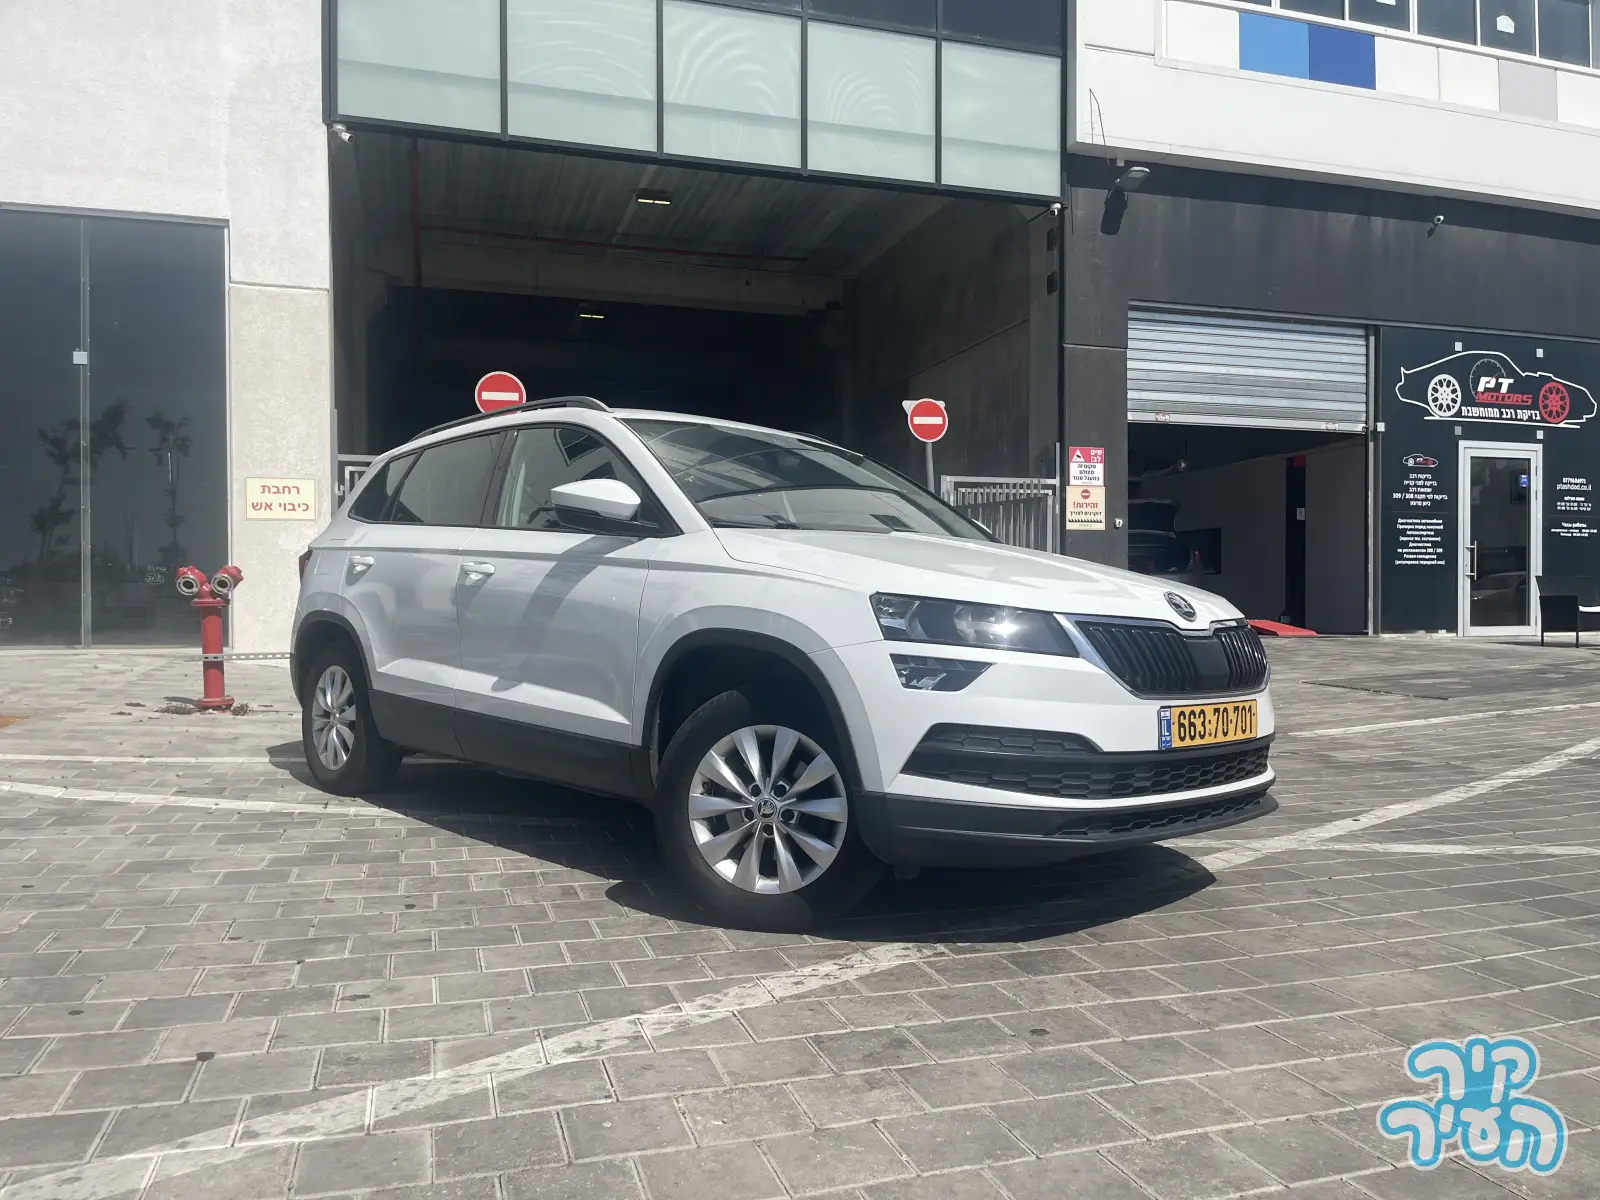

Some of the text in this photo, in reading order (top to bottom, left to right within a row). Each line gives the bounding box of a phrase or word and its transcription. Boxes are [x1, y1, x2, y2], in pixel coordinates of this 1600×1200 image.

[1477, 376, 1514, 394] PT
[1475, 391, 1533, 405] MOTORS
[1461, 406, 1541, 421] בדיקת רכב ממוחשבת
[260, 484, 300, 495] רחבת
[251, 501, 310, 512] כיבוי אש
[1073, 501, 1099, 509] זהירות!
[1161, 719, 1170, 736] IL
